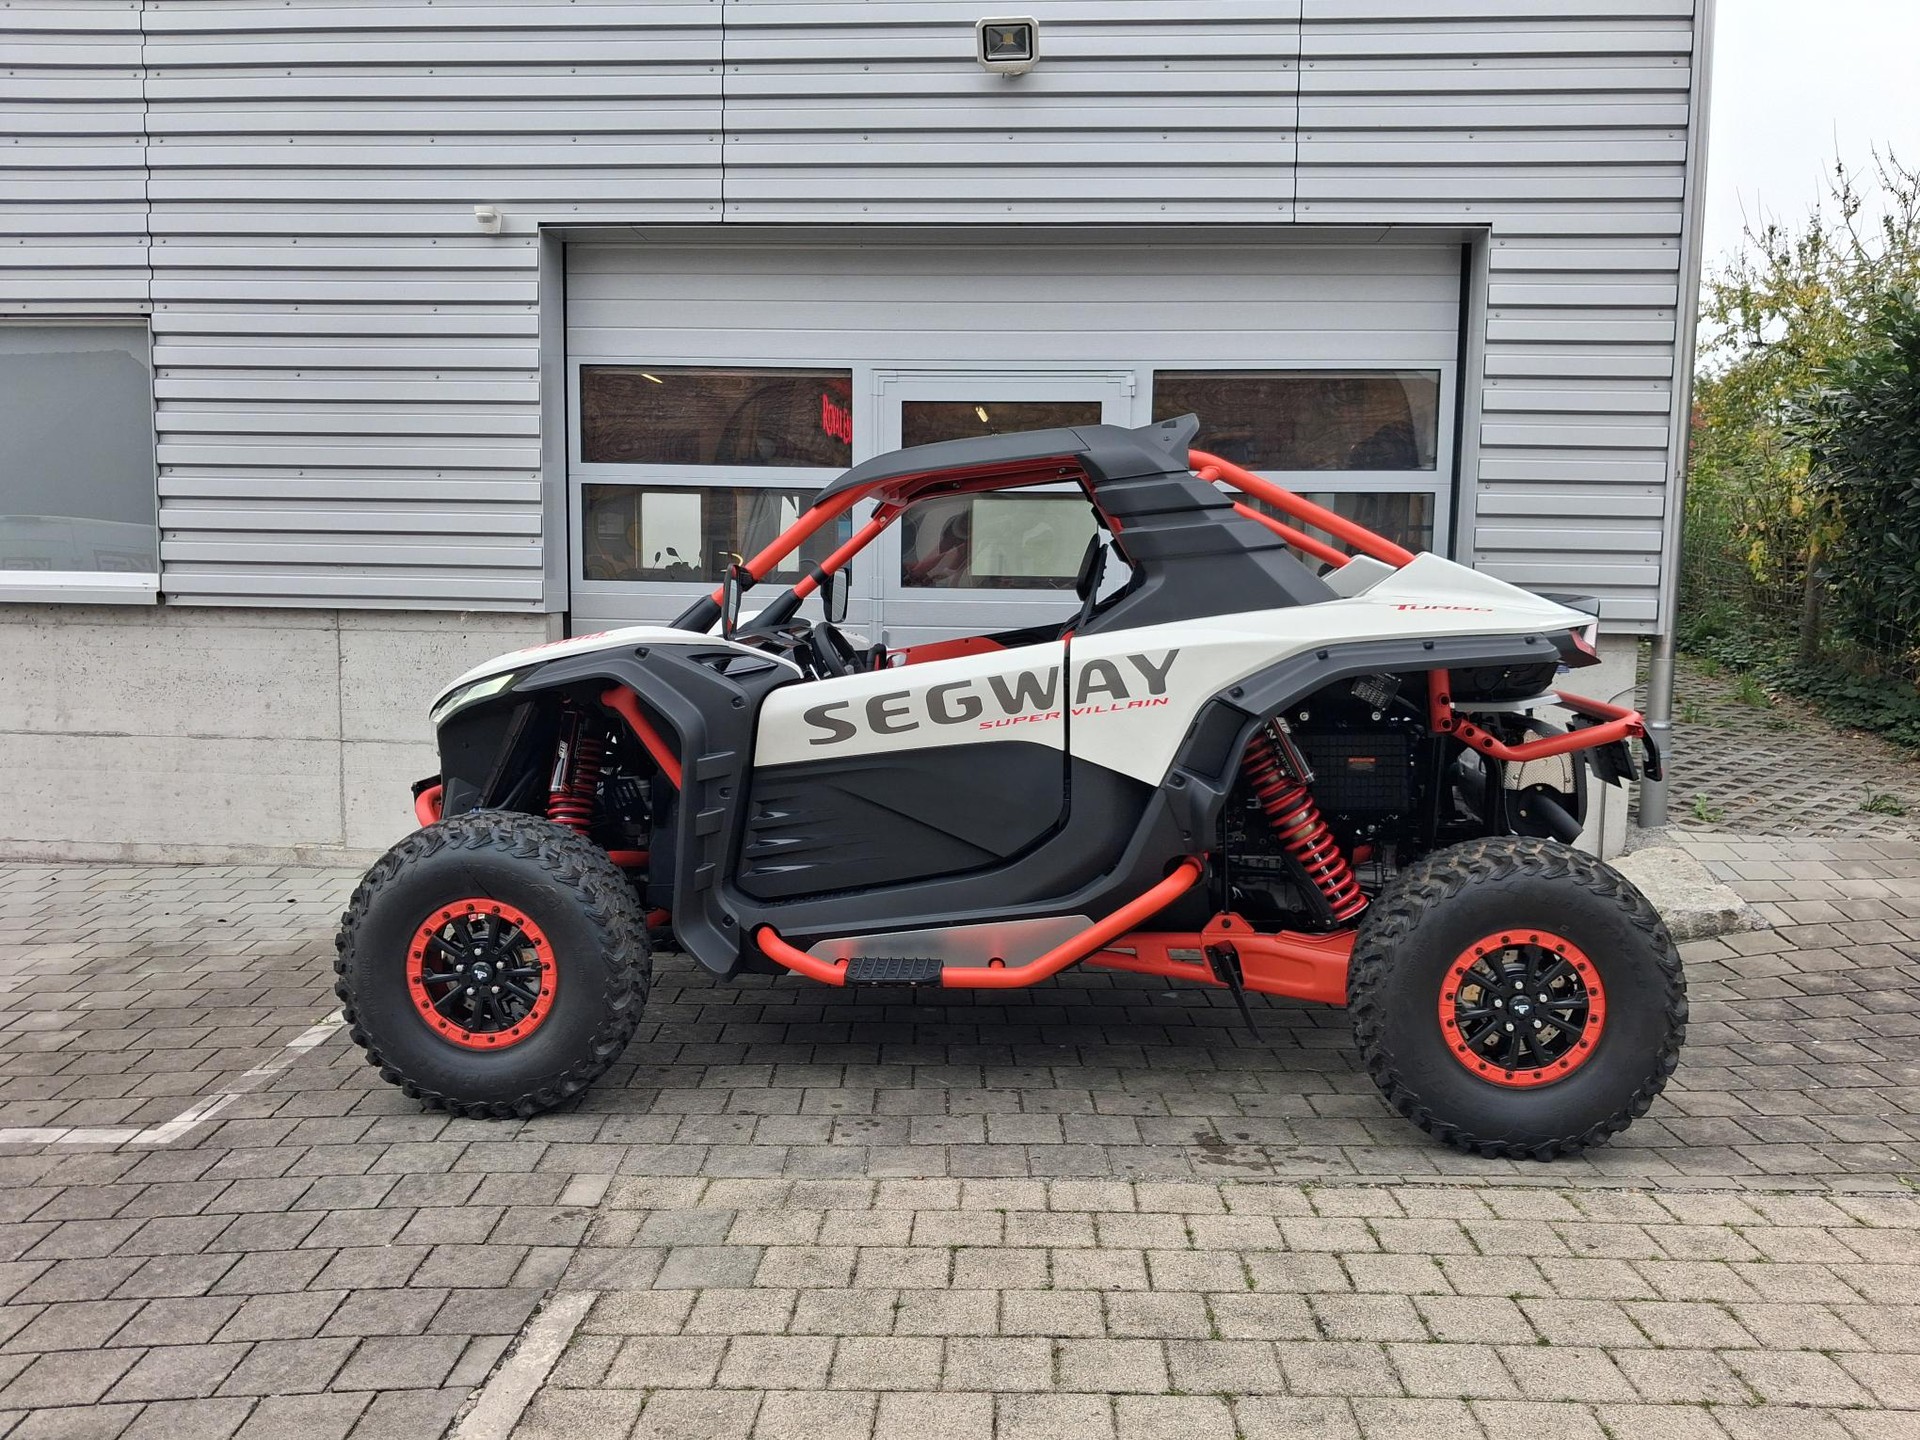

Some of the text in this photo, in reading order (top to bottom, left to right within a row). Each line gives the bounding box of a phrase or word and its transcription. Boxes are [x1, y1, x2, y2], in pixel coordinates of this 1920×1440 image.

[803, 649, 1180, 745] SEGWAY
[979, 697, 1169, 730] SUPER VILLAIN
